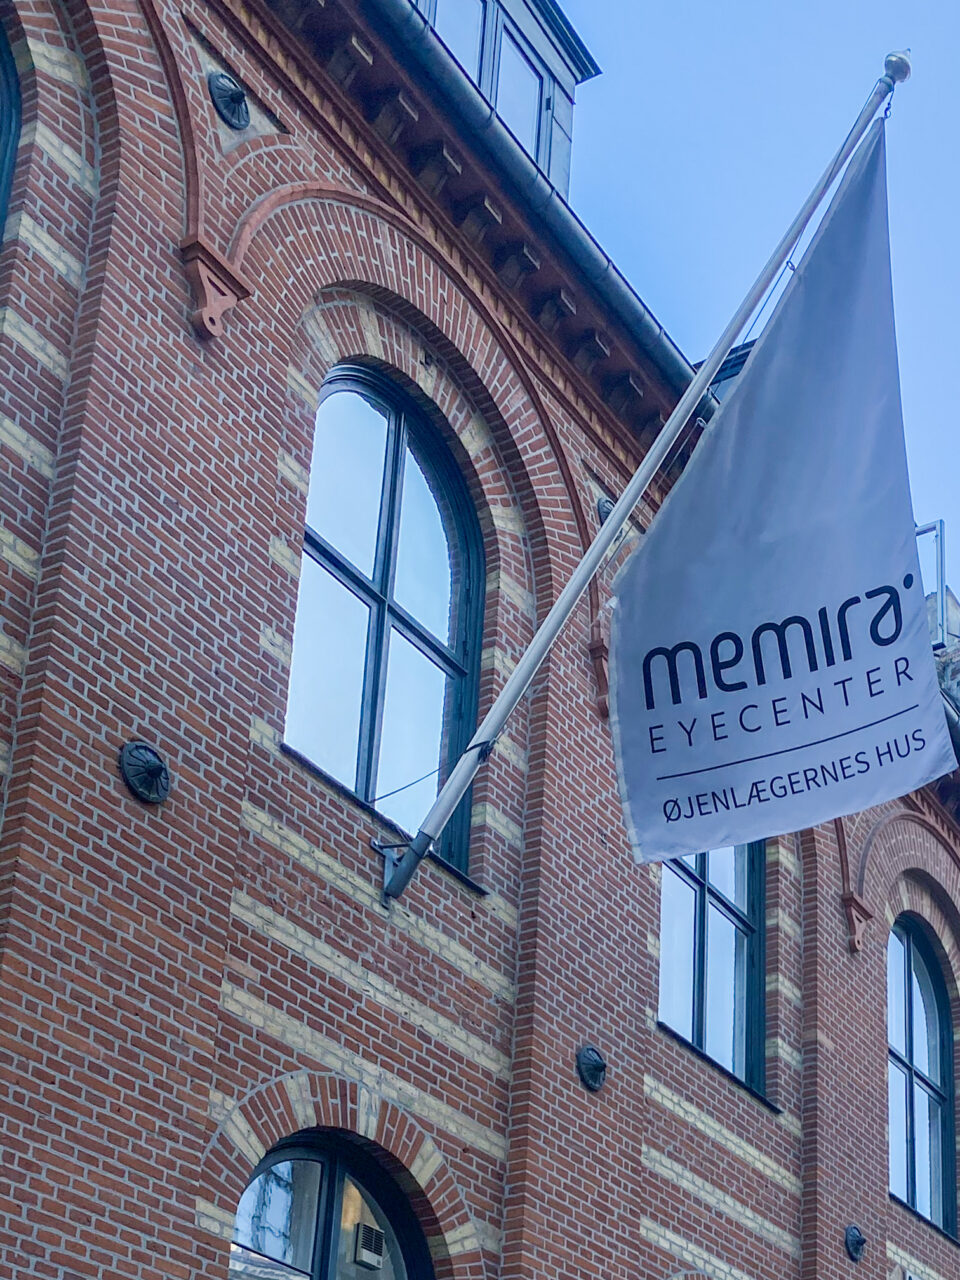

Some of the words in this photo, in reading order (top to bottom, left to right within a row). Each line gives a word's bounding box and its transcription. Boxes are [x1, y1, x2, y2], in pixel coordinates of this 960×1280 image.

[641, 583, 904, 711] memira
[648, 656, 914, 755] EYECENTER
[662, 751, 871, 824] ØJENLÆGERNES
[875, 728, 927, 767] HUS
